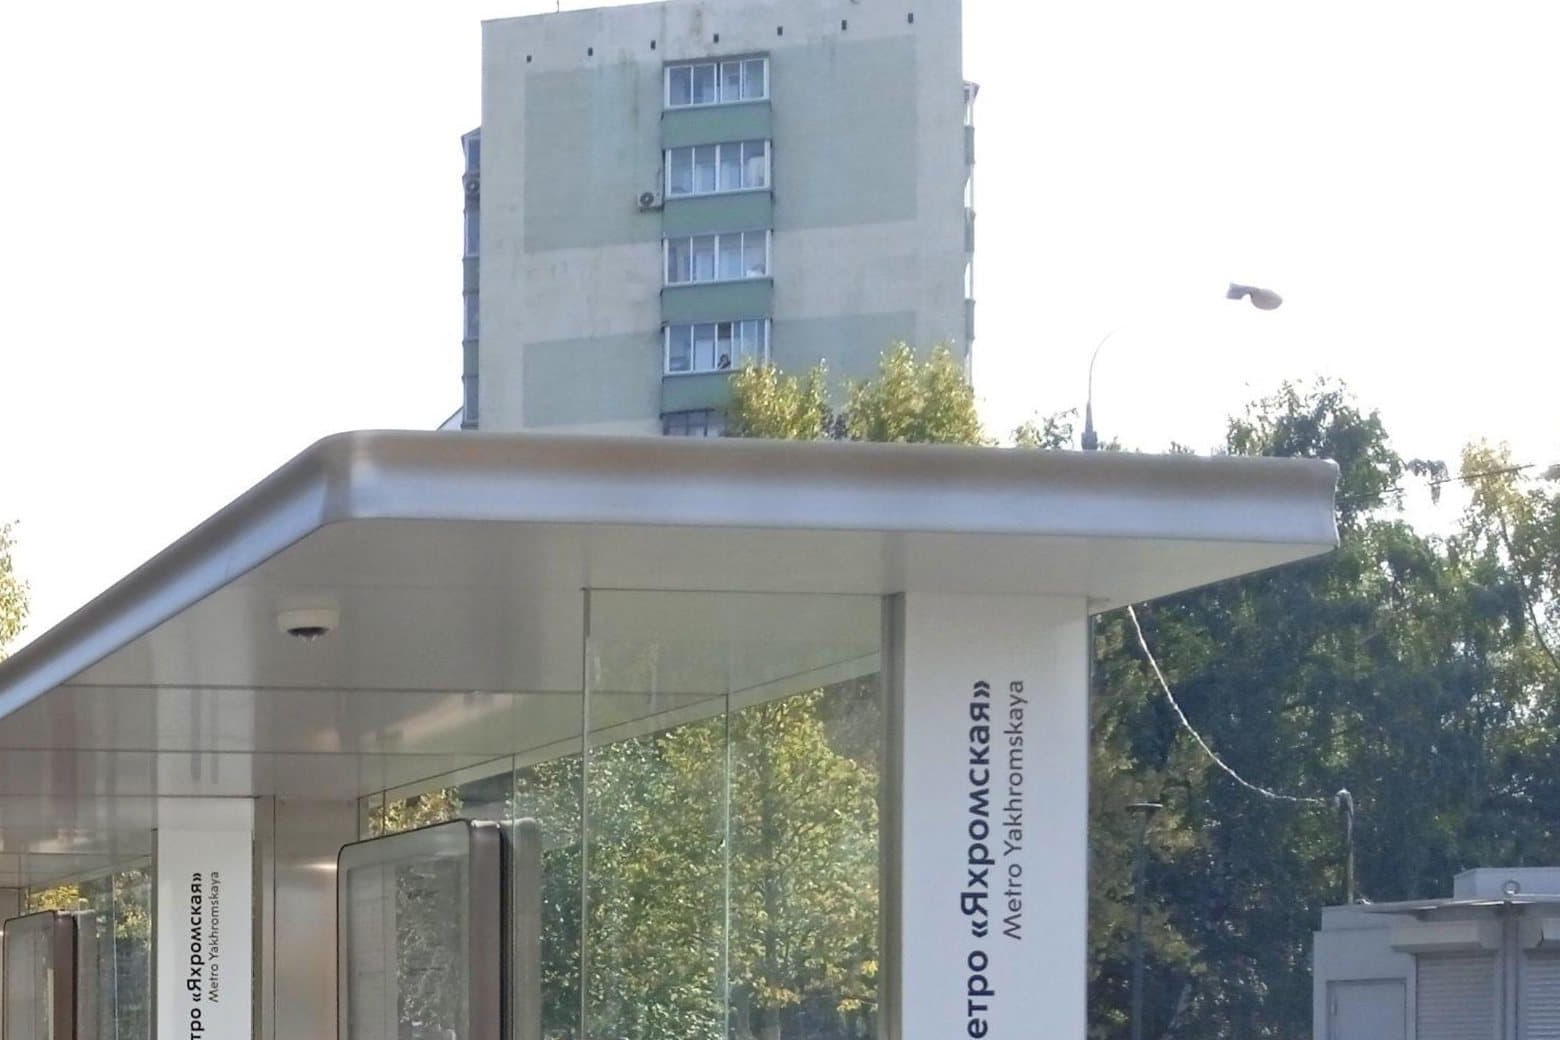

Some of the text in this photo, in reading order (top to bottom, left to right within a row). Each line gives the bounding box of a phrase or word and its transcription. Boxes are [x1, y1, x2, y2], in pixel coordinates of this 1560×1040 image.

[961, 680, 994, 938] «Яхромская»
[1003, 680, 1028, 940] Metro Yakhromskaya
[187, 872, 205, 1002] «Яхромская»
[208, 871, 221, 1003] Metro Yakhromskaya
